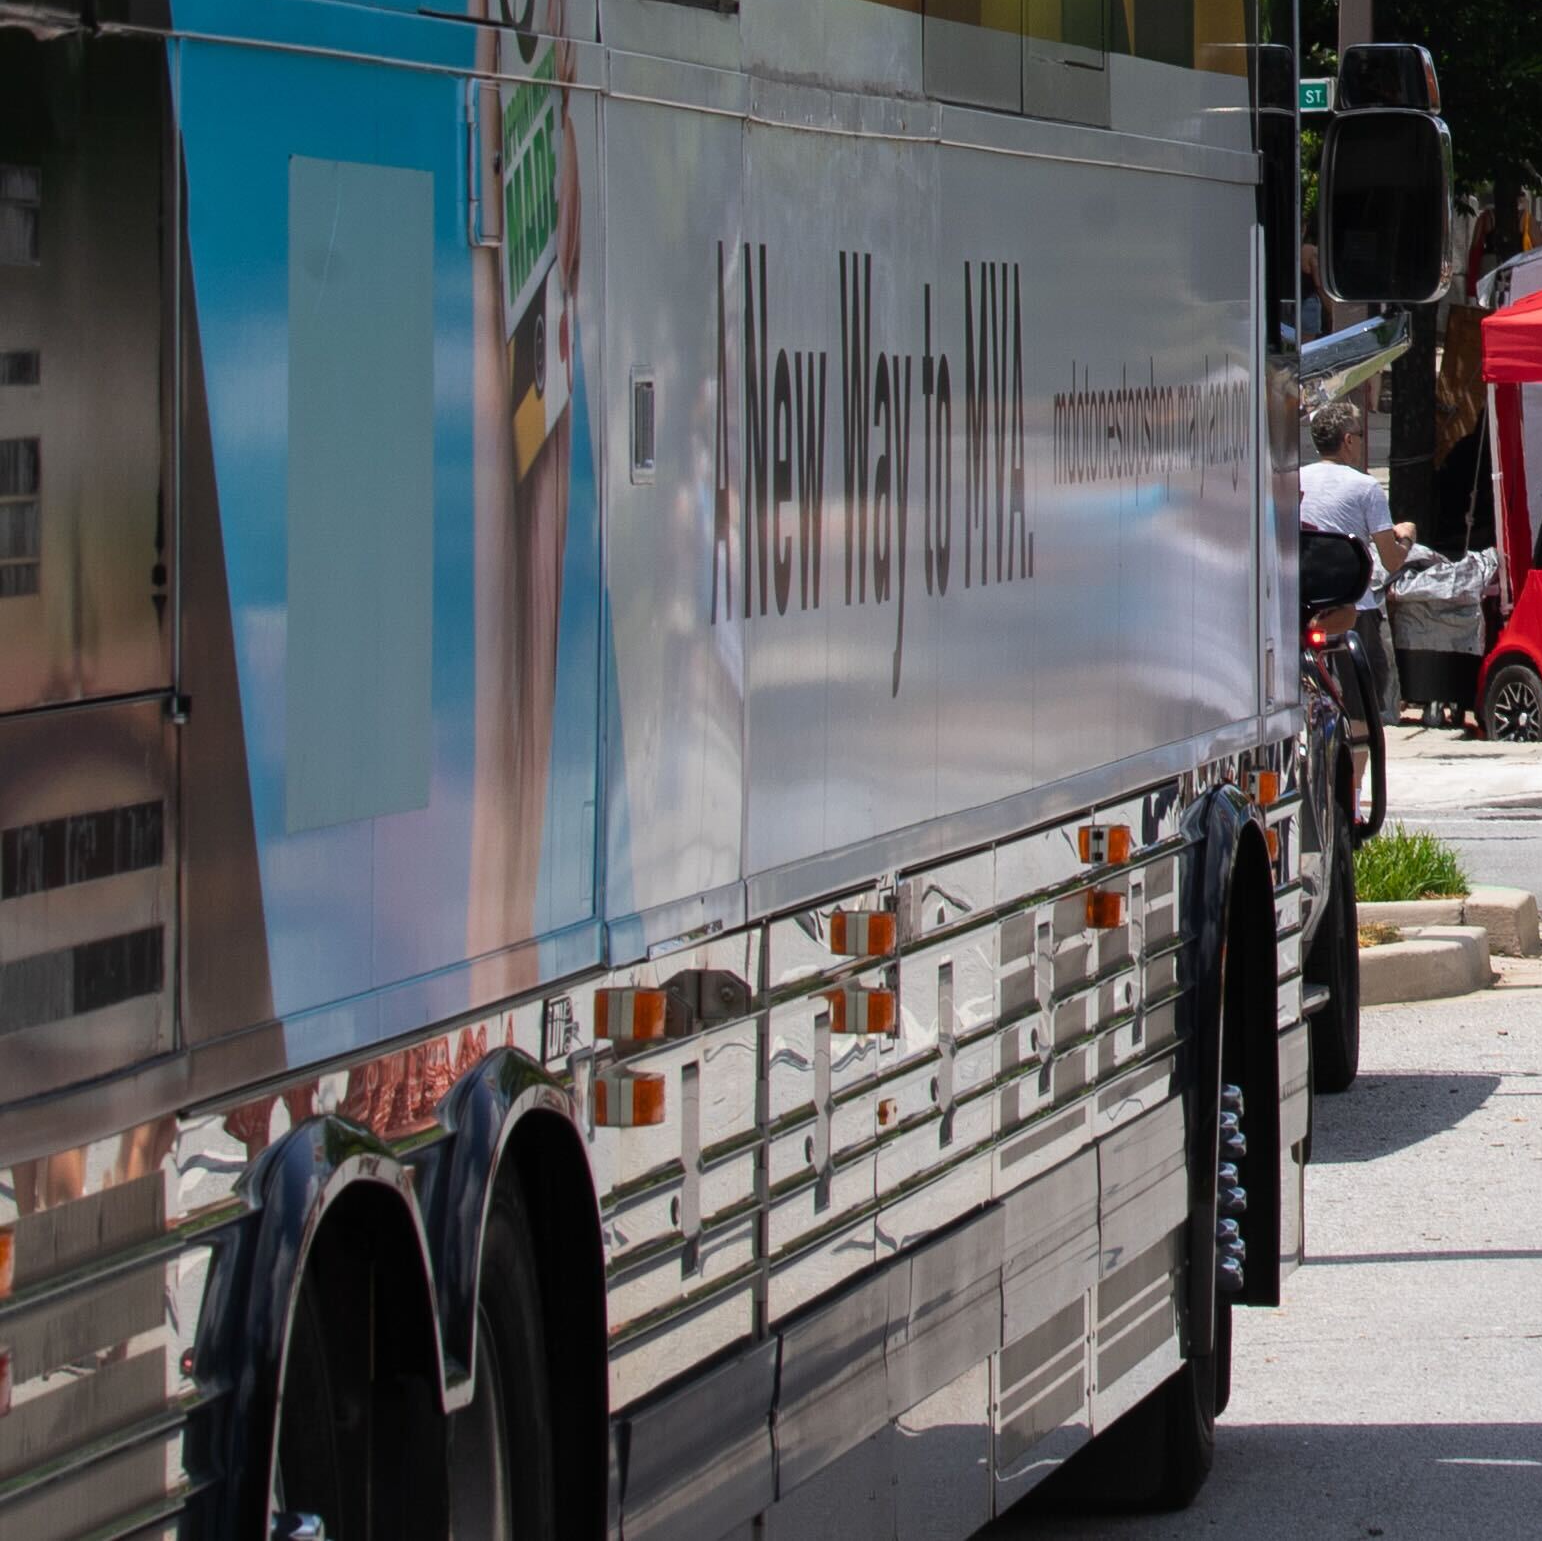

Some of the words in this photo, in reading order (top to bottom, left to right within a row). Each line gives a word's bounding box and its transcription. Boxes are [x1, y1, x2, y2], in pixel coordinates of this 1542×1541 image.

[504, 104, 559, 307] MADE
[710, 240, 732, 626] A
[743, 241, 827, 619] New
[839, 250, 912, 699] Way
[922, 283, 951, 597] to
